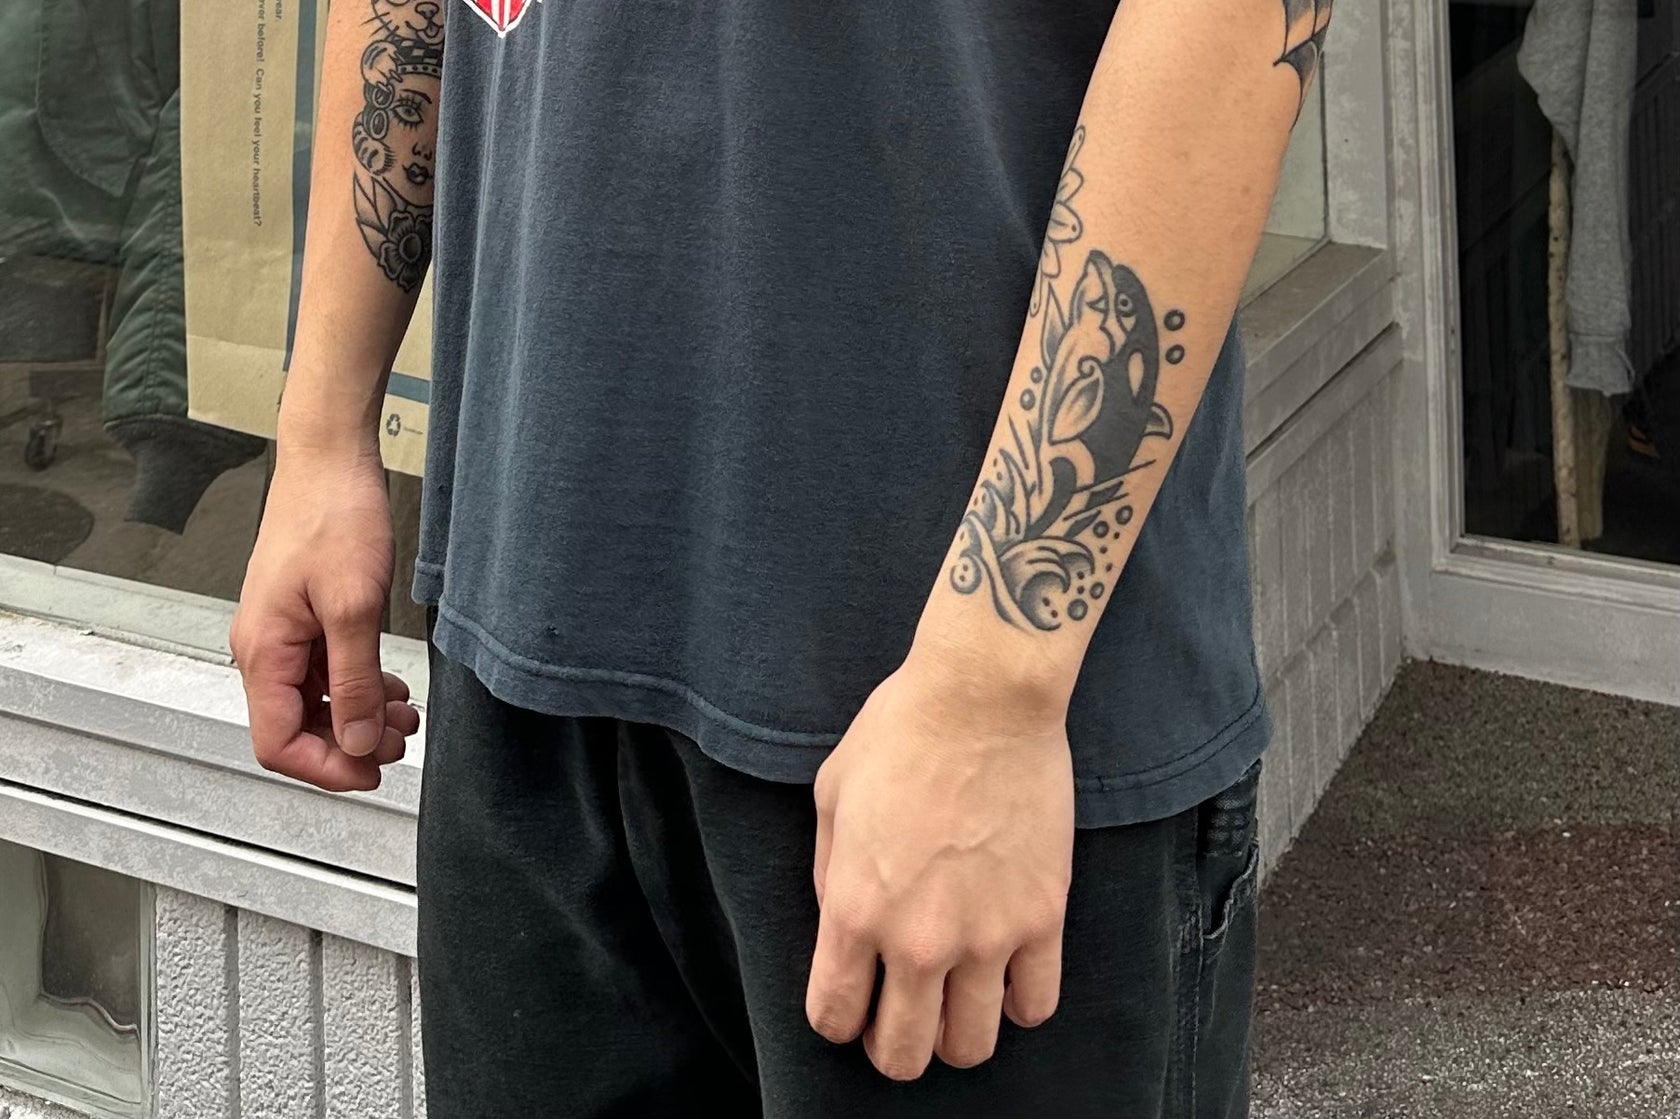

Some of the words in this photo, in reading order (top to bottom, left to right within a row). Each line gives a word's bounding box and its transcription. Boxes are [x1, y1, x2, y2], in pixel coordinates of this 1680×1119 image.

[255, 68, 265, 90] Can
[252, 94, 262, 114] you
[253, 117, 263, 137] feel
[251, 140, 262, 165] your
[252, 168, 263, 226] heartbeat?
